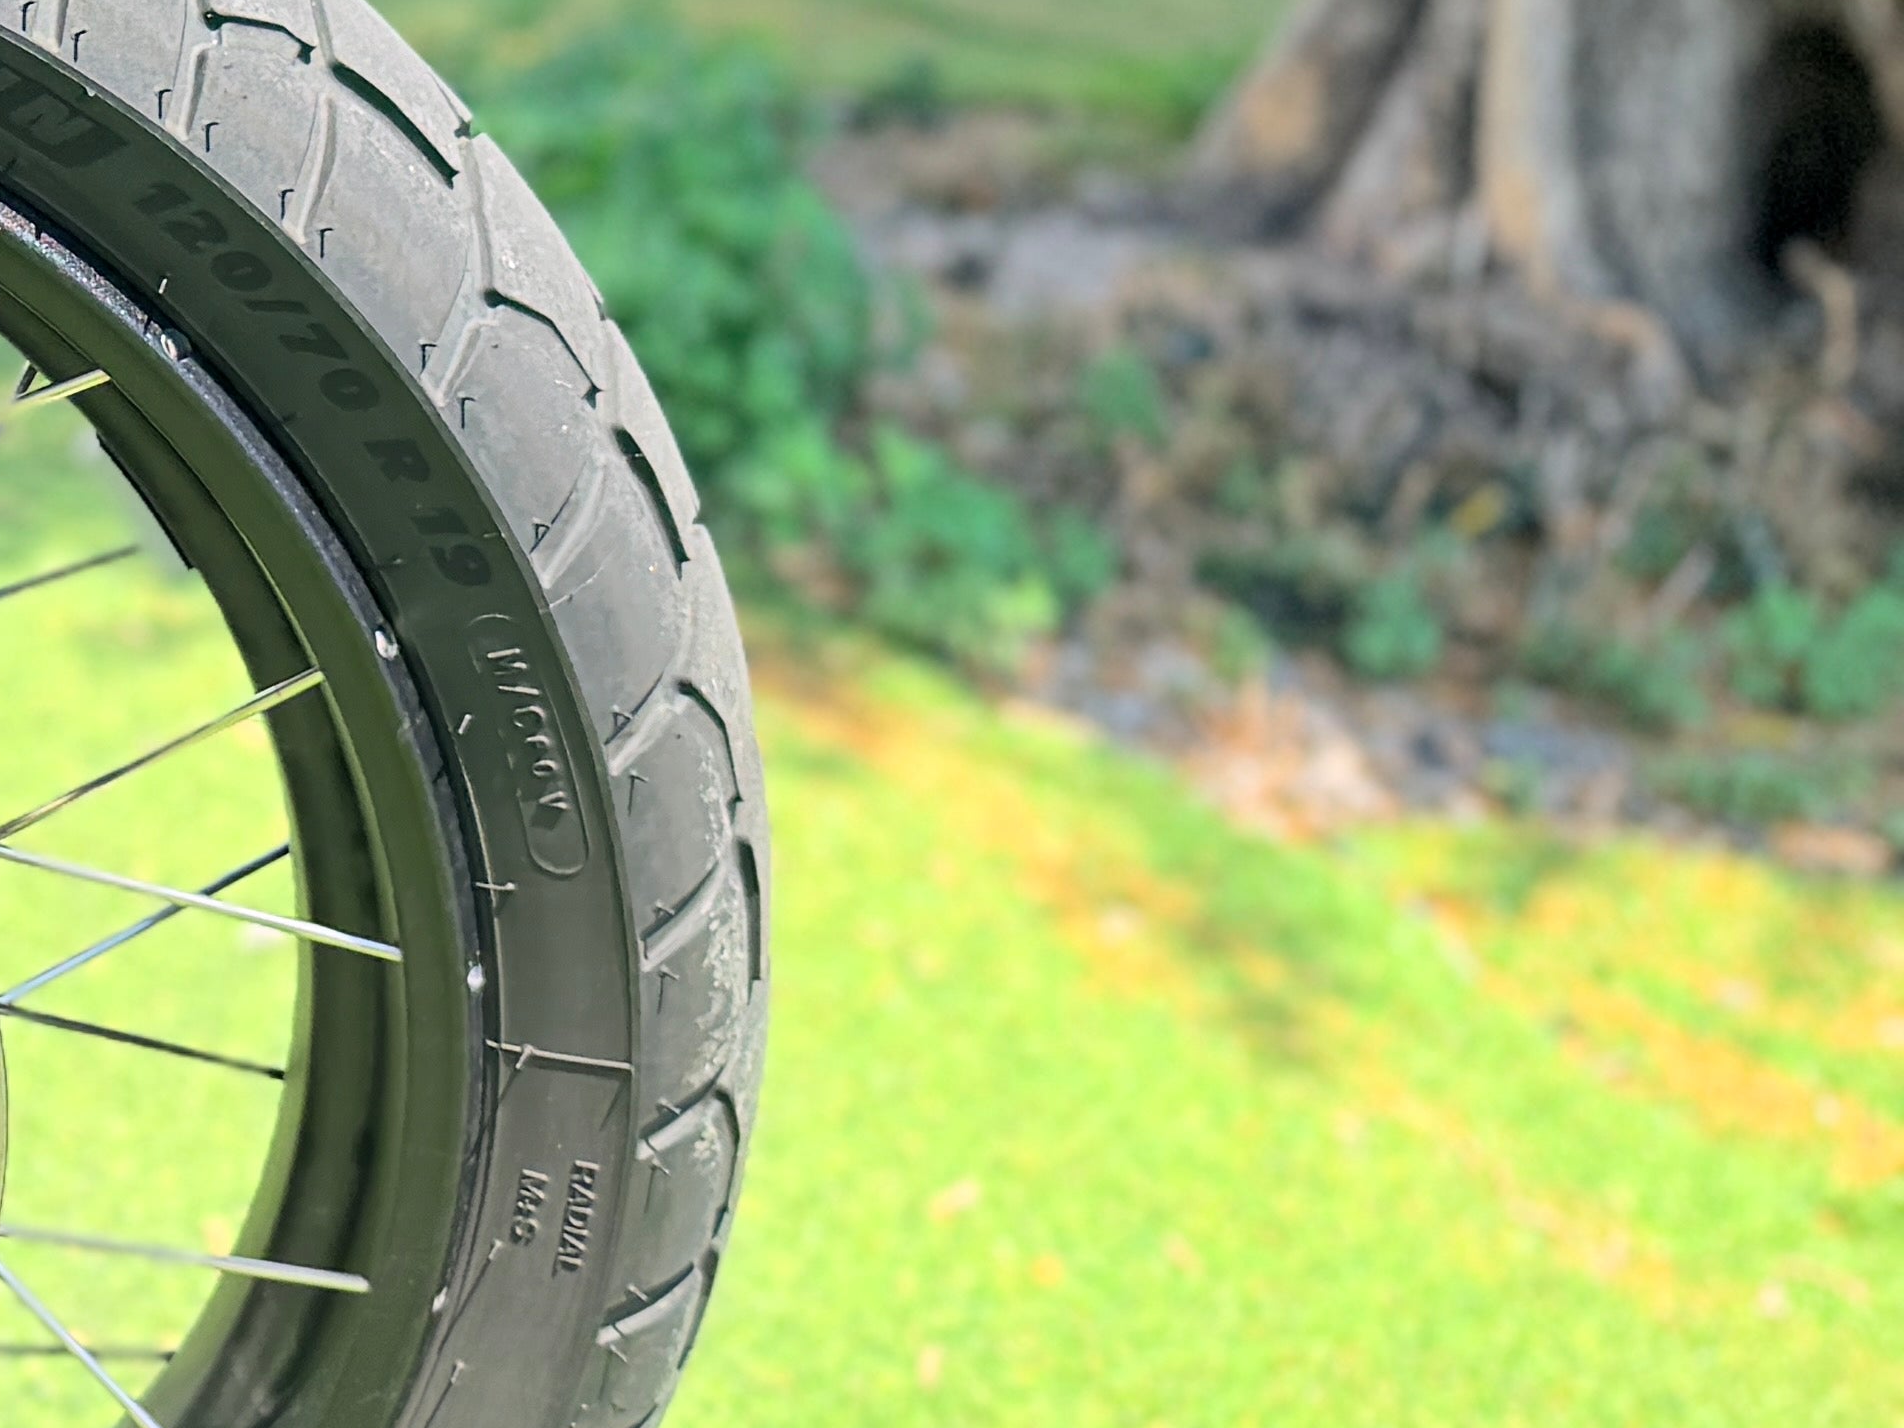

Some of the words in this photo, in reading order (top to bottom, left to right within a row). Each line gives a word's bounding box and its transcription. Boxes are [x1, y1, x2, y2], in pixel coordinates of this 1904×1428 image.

[133, 180, 382, 415] 120/70
[363, 436, 432, 487] R
[409, 504, 494, 589] 19
[559, 1159, 600, 1276] RADIAL
